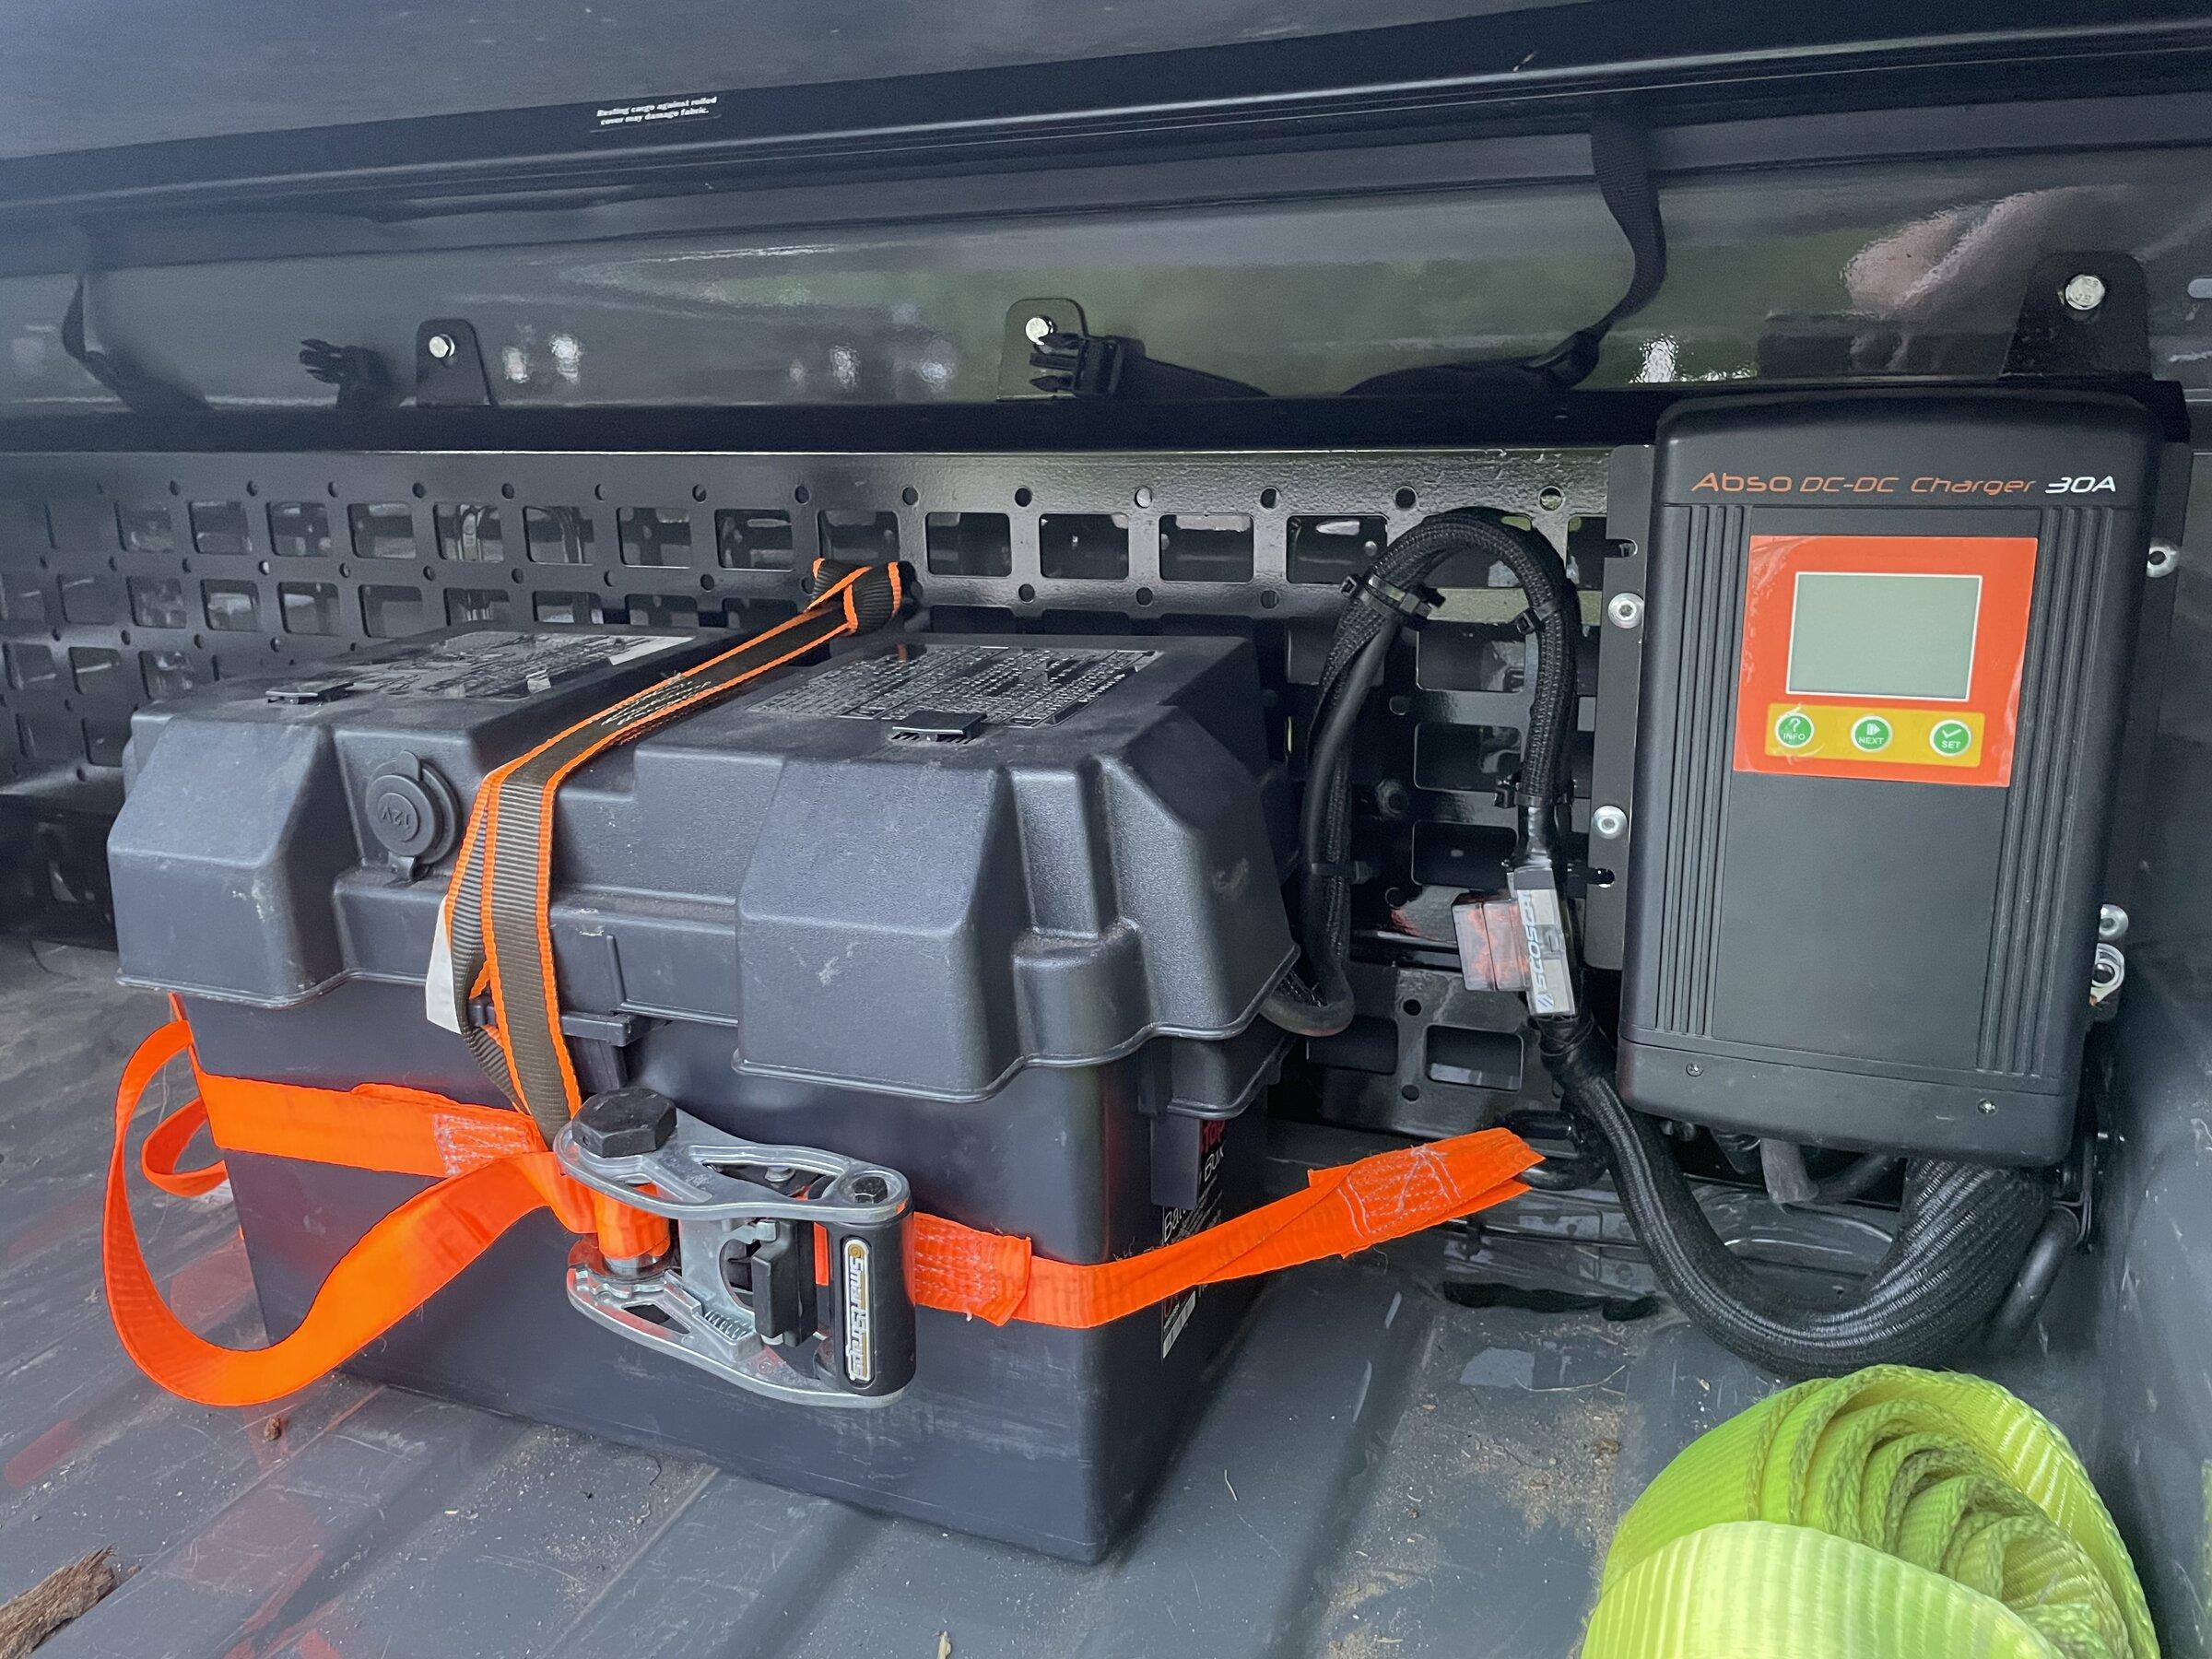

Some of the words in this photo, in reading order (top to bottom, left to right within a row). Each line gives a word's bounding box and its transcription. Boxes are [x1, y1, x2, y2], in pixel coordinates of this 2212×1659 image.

[630, 104, 656, 113] cargo
[656, 100, 689, 111] against
[690, 96, 718, 107] rolled
[600, 117, 624, 125] cover
[644, 112, 680, 120] damage
[1690, 472, 1792, 493] Abso
[1799, 477, 1900, 493] DC-DC
[1911, 477, 2037, 496] Charger
[2045, 476, 2117, 494] 30A
[1783, 732, 1806, 741] INFO
[1858, 736, 1885, 745] NEXT
[1941, 740, 1961, 749] SET
[381, 806, 411, 829] 12V
[1520, 889, 1547, 990] SCOSCH
